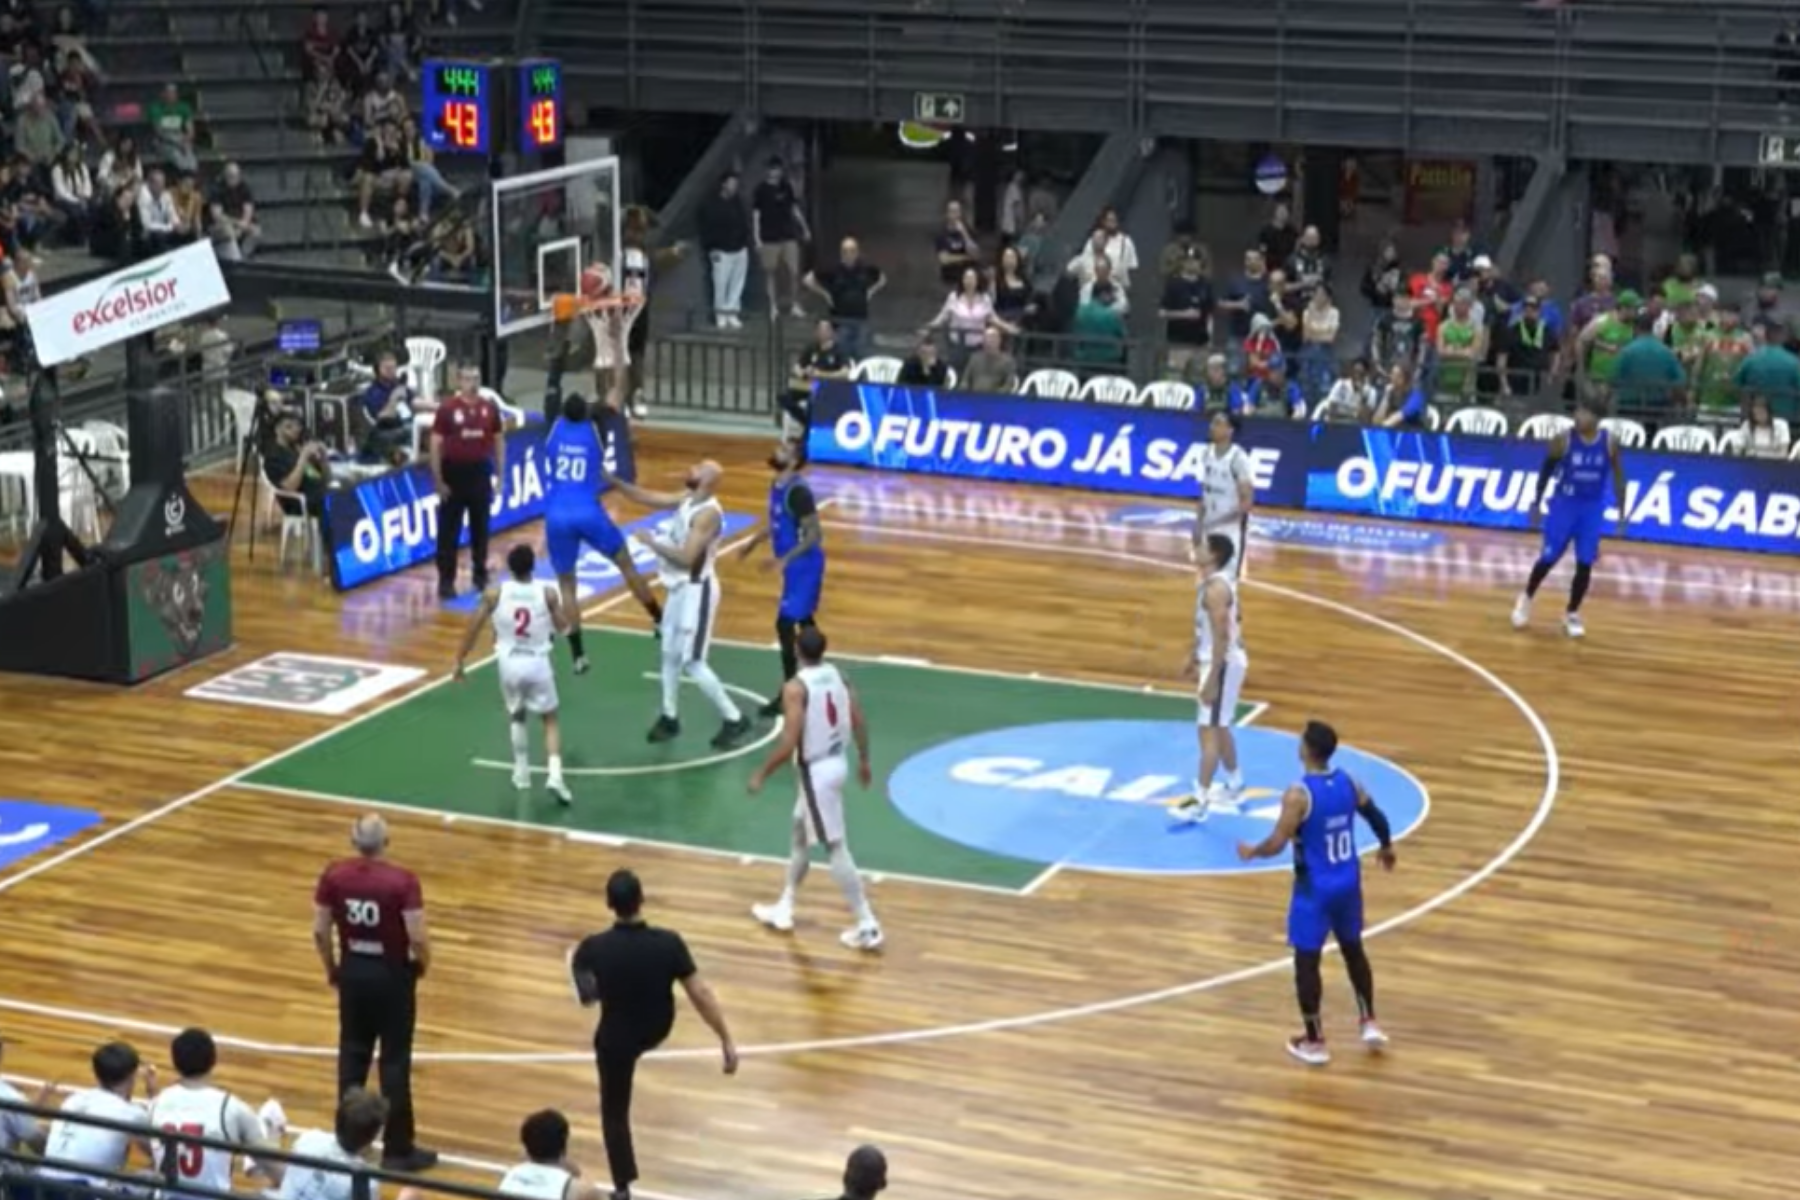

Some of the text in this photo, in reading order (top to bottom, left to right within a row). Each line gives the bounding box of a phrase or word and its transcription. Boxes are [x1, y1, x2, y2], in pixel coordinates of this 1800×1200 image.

[445, 100, 478, 146] 43
[531, 99, 555, 144] 43
[71, 277, 178, 335] excelsior
[555, 456, 587, 482] 20
[834, 411, 1281, 490] O FUTURO JÁ SAE
[353, 516, 381, 563] O
[508, 445, 544, 509] JÁ
[1336, 456, 1377, 498] O
[1381, 459, 1556, 516] FUTUR
[1682, 485, 1800, 538] SAB
[514, 607, 531, 638] 2
[949, 756, 1283, 820] CAI
[1325, 830, 1352, 864] 10
[345, 898, 380, 927] 30
